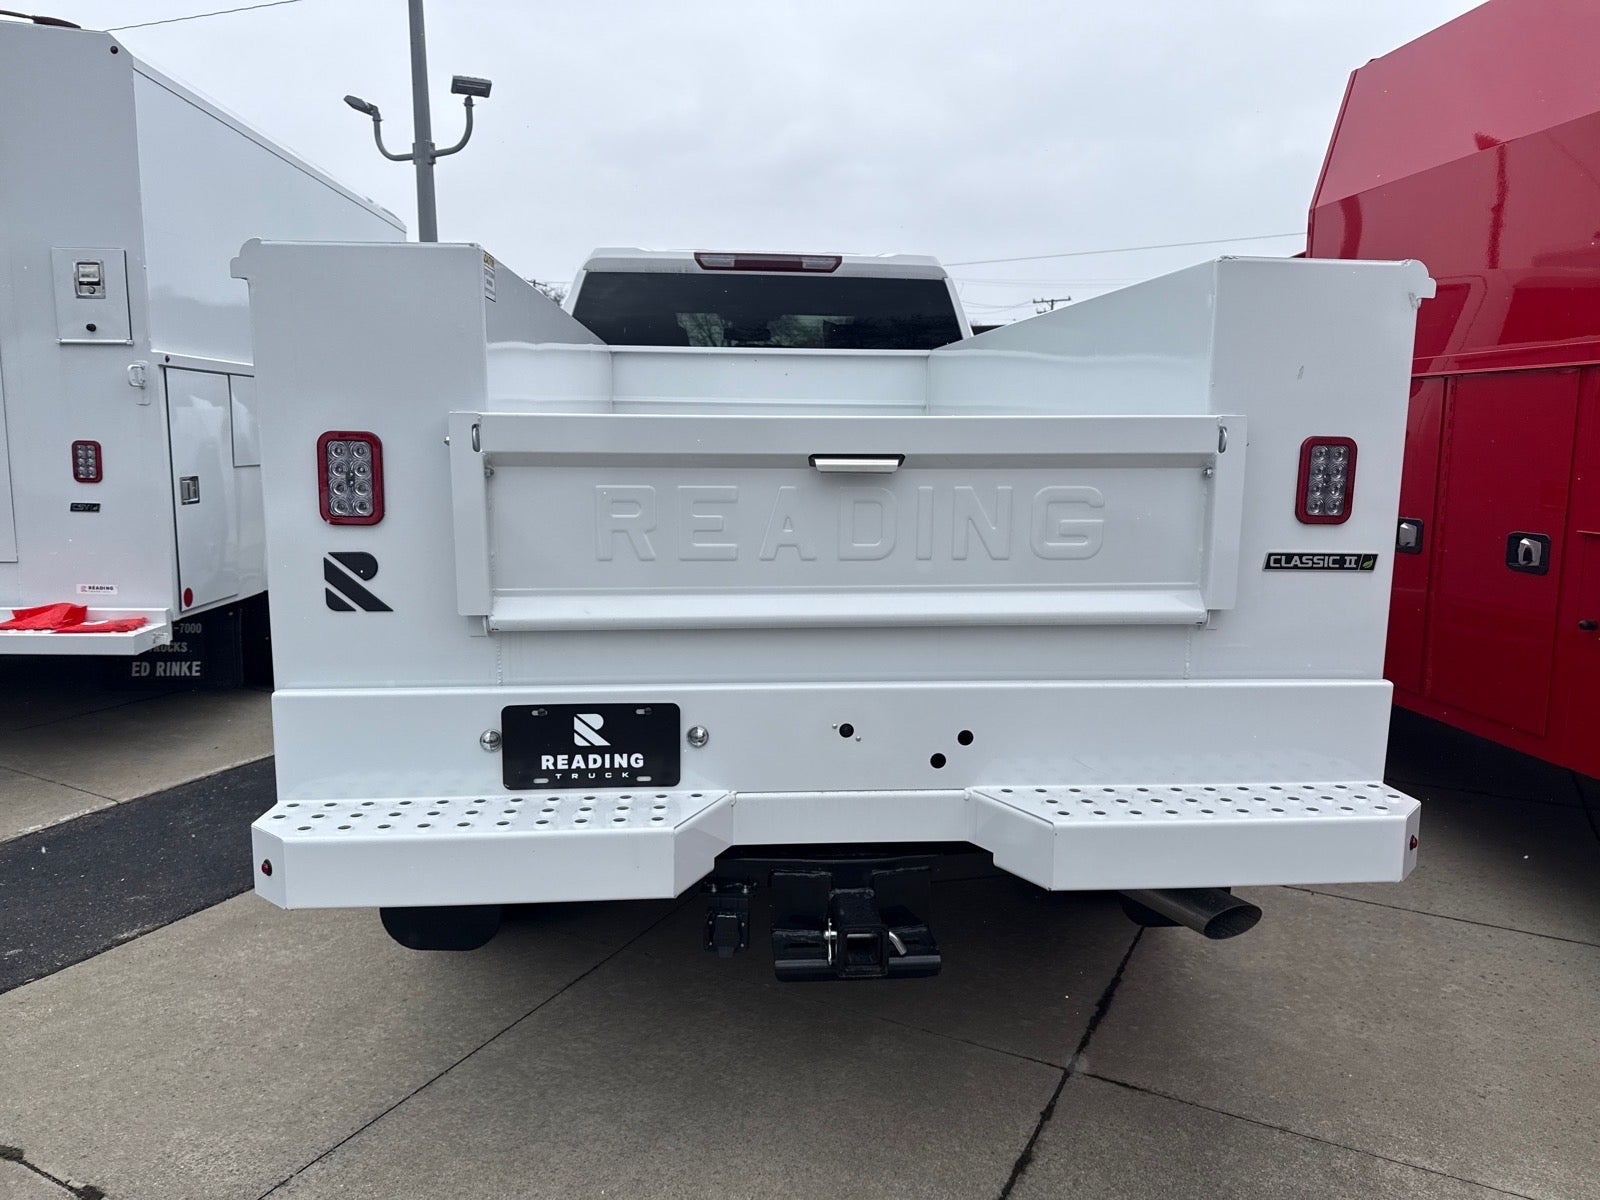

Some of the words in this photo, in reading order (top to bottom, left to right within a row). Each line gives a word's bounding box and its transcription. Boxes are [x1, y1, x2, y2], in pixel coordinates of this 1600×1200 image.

[594, 484, 1106, 561] READING
[1269, 555, 1341, 568] CLASSIC
[1343, 556, 1358, 568] II
[131, 661, 151, 677] ED
[156, 661, 202, 677] RINKE
[541, 752, 645, 770] READING
[555, 771, 630, 779] TRUCK
